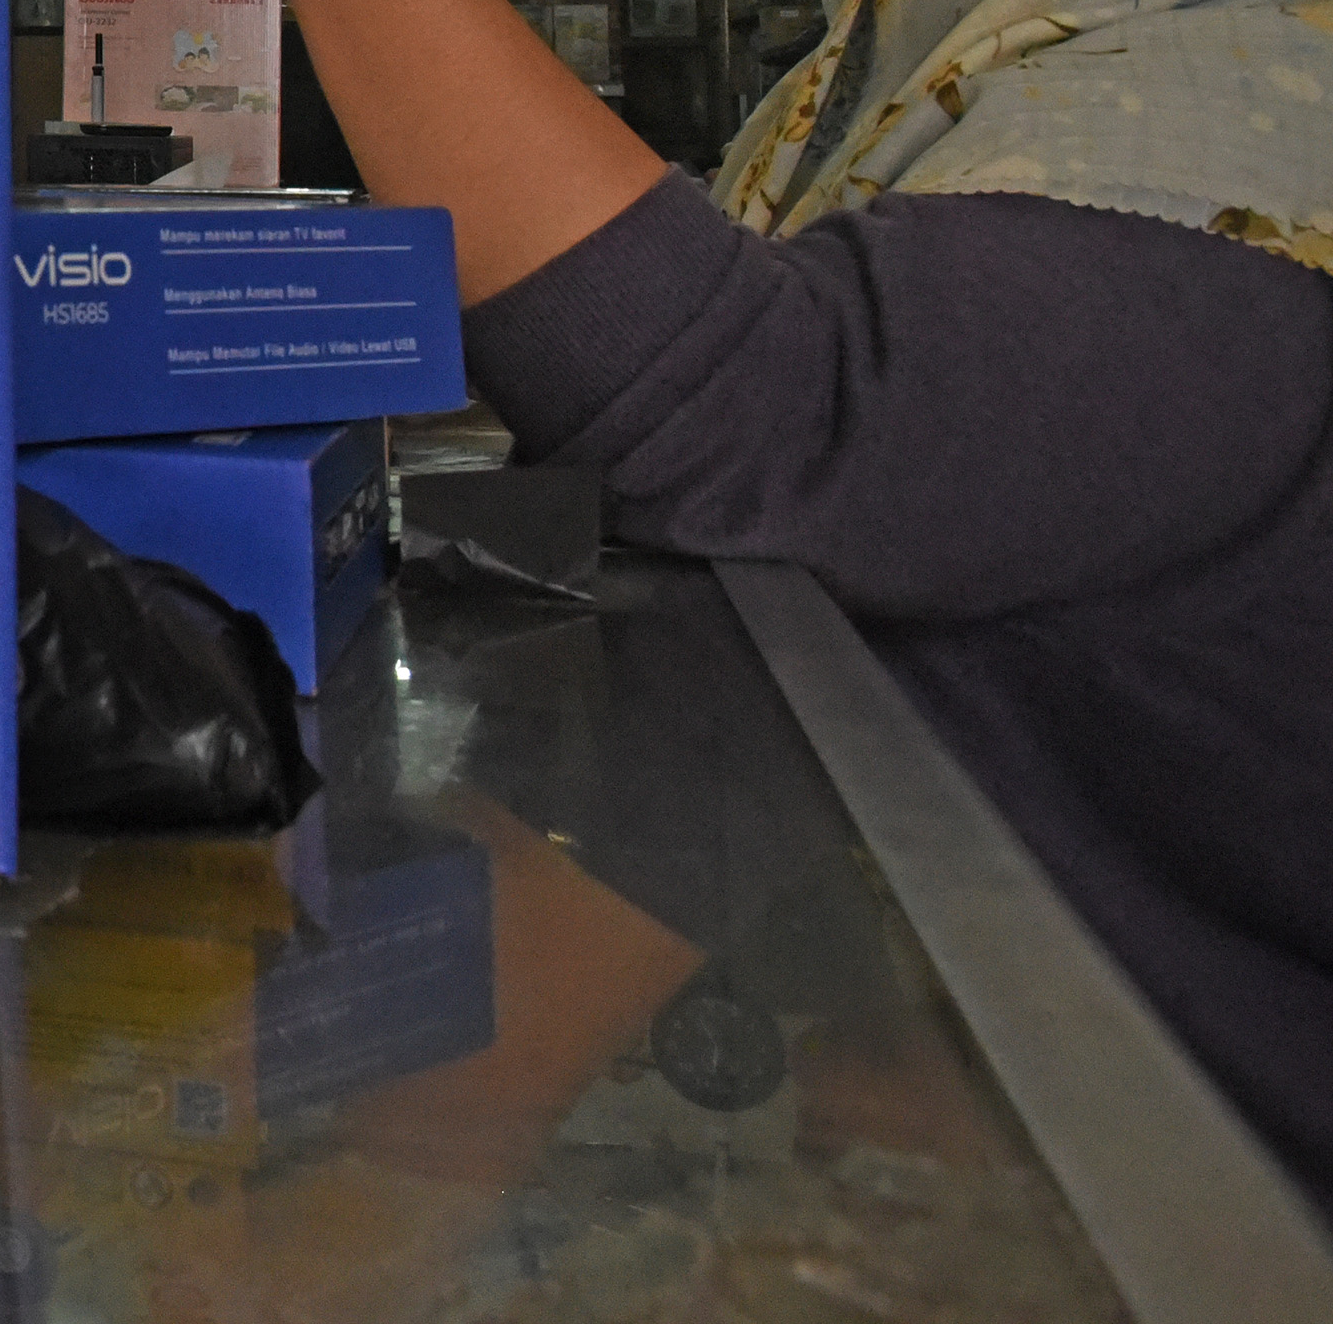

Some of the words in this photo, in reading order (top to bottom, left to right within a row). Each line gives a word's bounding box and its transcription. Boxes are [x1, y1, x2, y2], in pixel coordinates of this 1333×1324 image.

[160, 228, 201, 244] Mampu
[204, 228, 254, 243] merekam
[257, 227, 291, 242] siaran
[294, 227, 309, 240] TV
[164, 287, 243, 305] Menggunakan
[168, 347, 211, 364] Mampu
[288, 342, 320, 357] Audio
[328, 339, 360, 354] Video
[394, 337, 417, 352] USB
